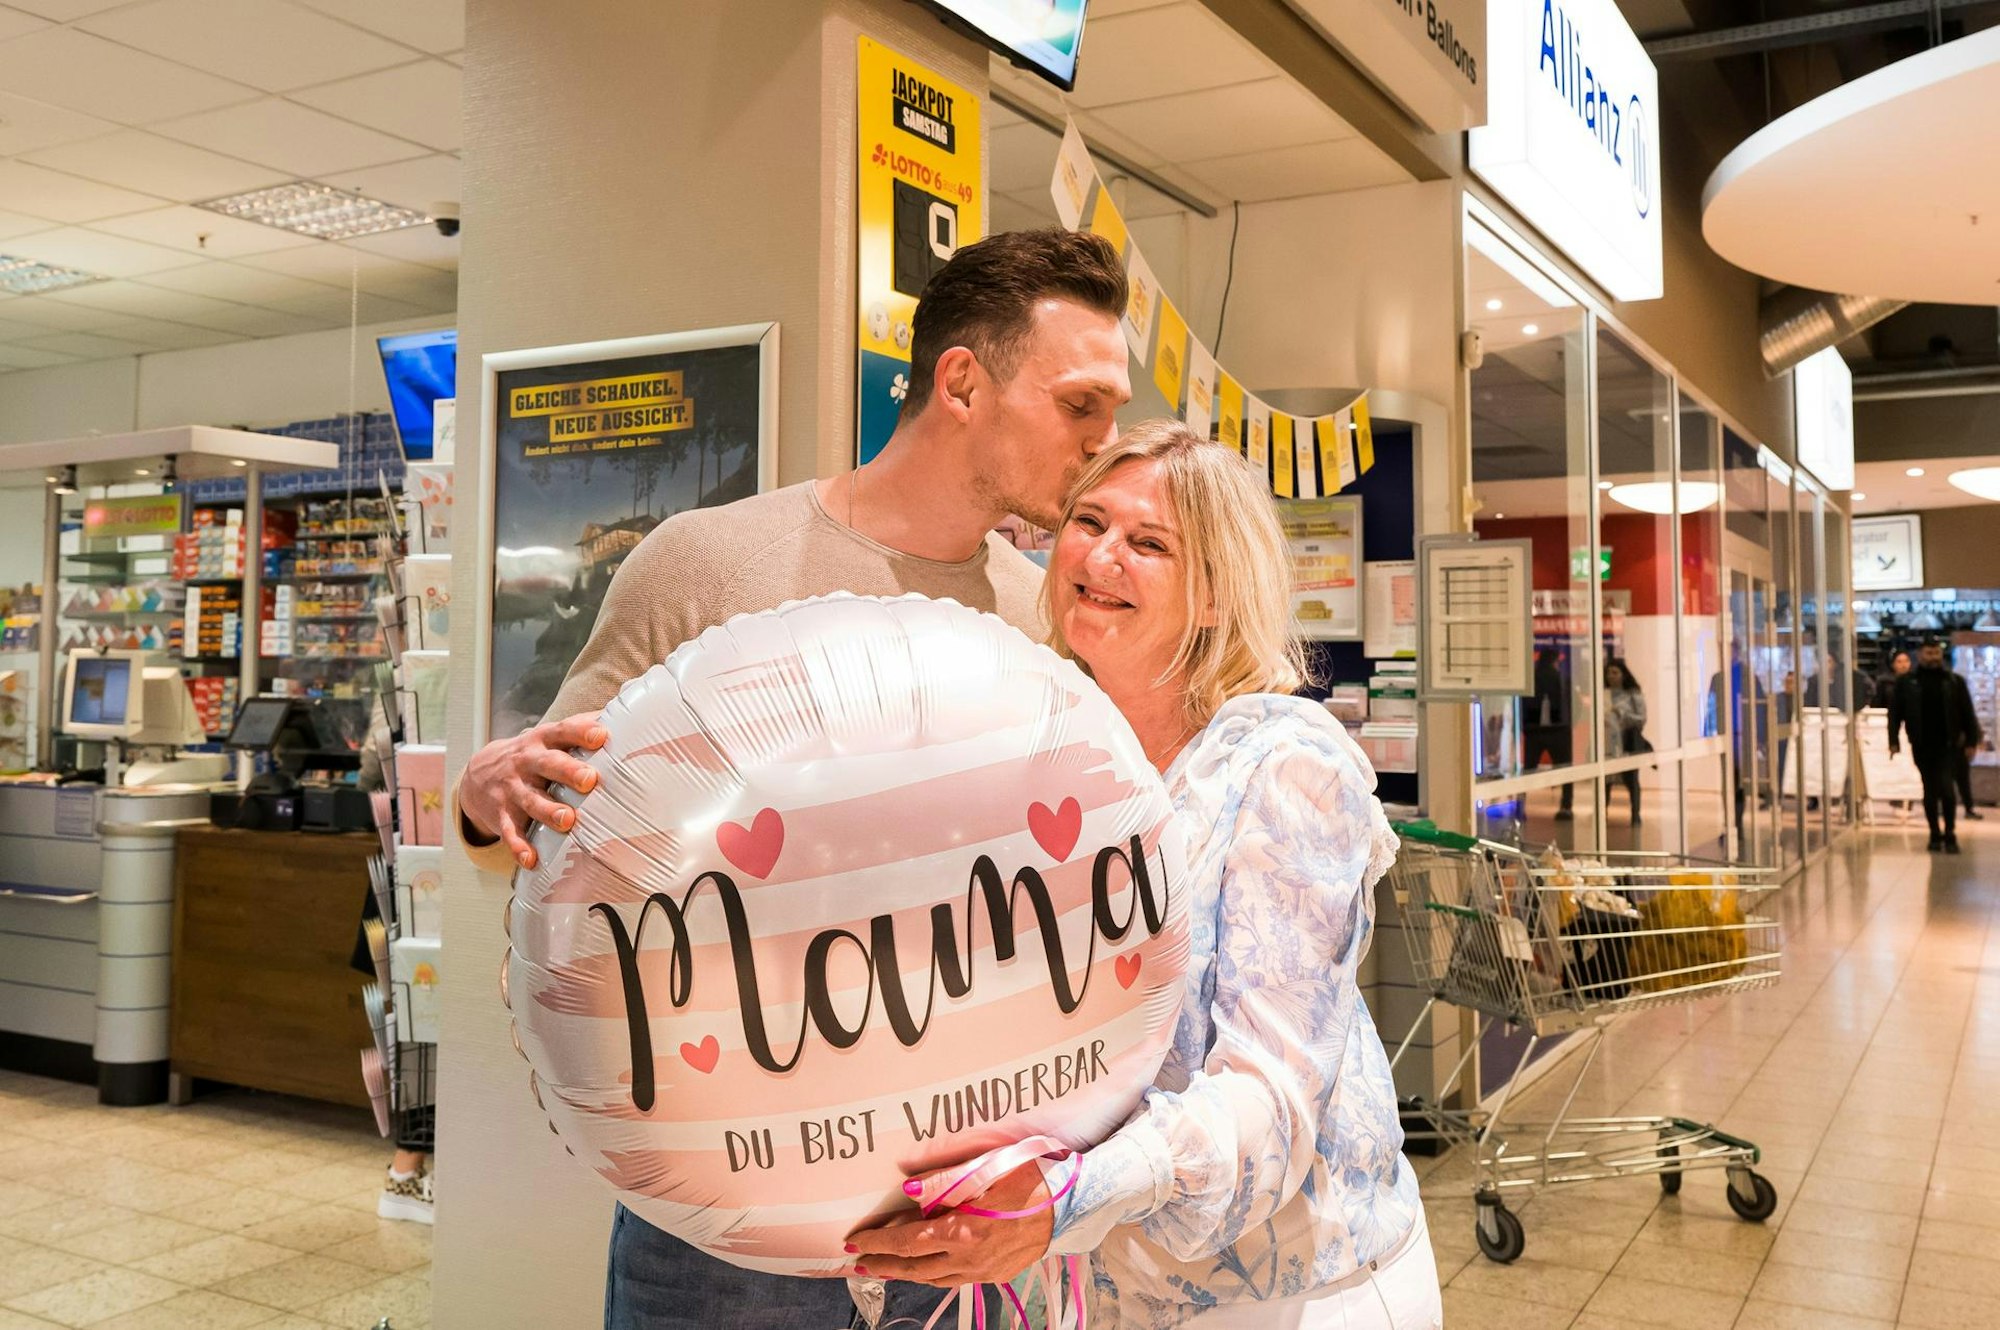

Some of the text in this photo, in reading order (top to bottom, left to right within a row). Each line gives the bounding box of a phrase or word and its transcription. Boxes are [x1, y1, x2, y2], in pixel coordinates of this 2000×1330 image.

[1427, 0, 1476, 85] Ballons
[891, 68, 954, 123] JACKPOT
[1540, 0, 1622, 167] Allianz
[902, 106, 949, 145] SAMSTAG
[890, 150, 932, 185] LOTTO
[515, 379, 678, 411] GLEICHE SCHAUKEL.
[554, 405, 689, 436] NEUE AUSSICHT.
[588, 834, 1169, 1112] Mama
[725, 1039, 1109, 1173] DU BIST WUNDERBAR
